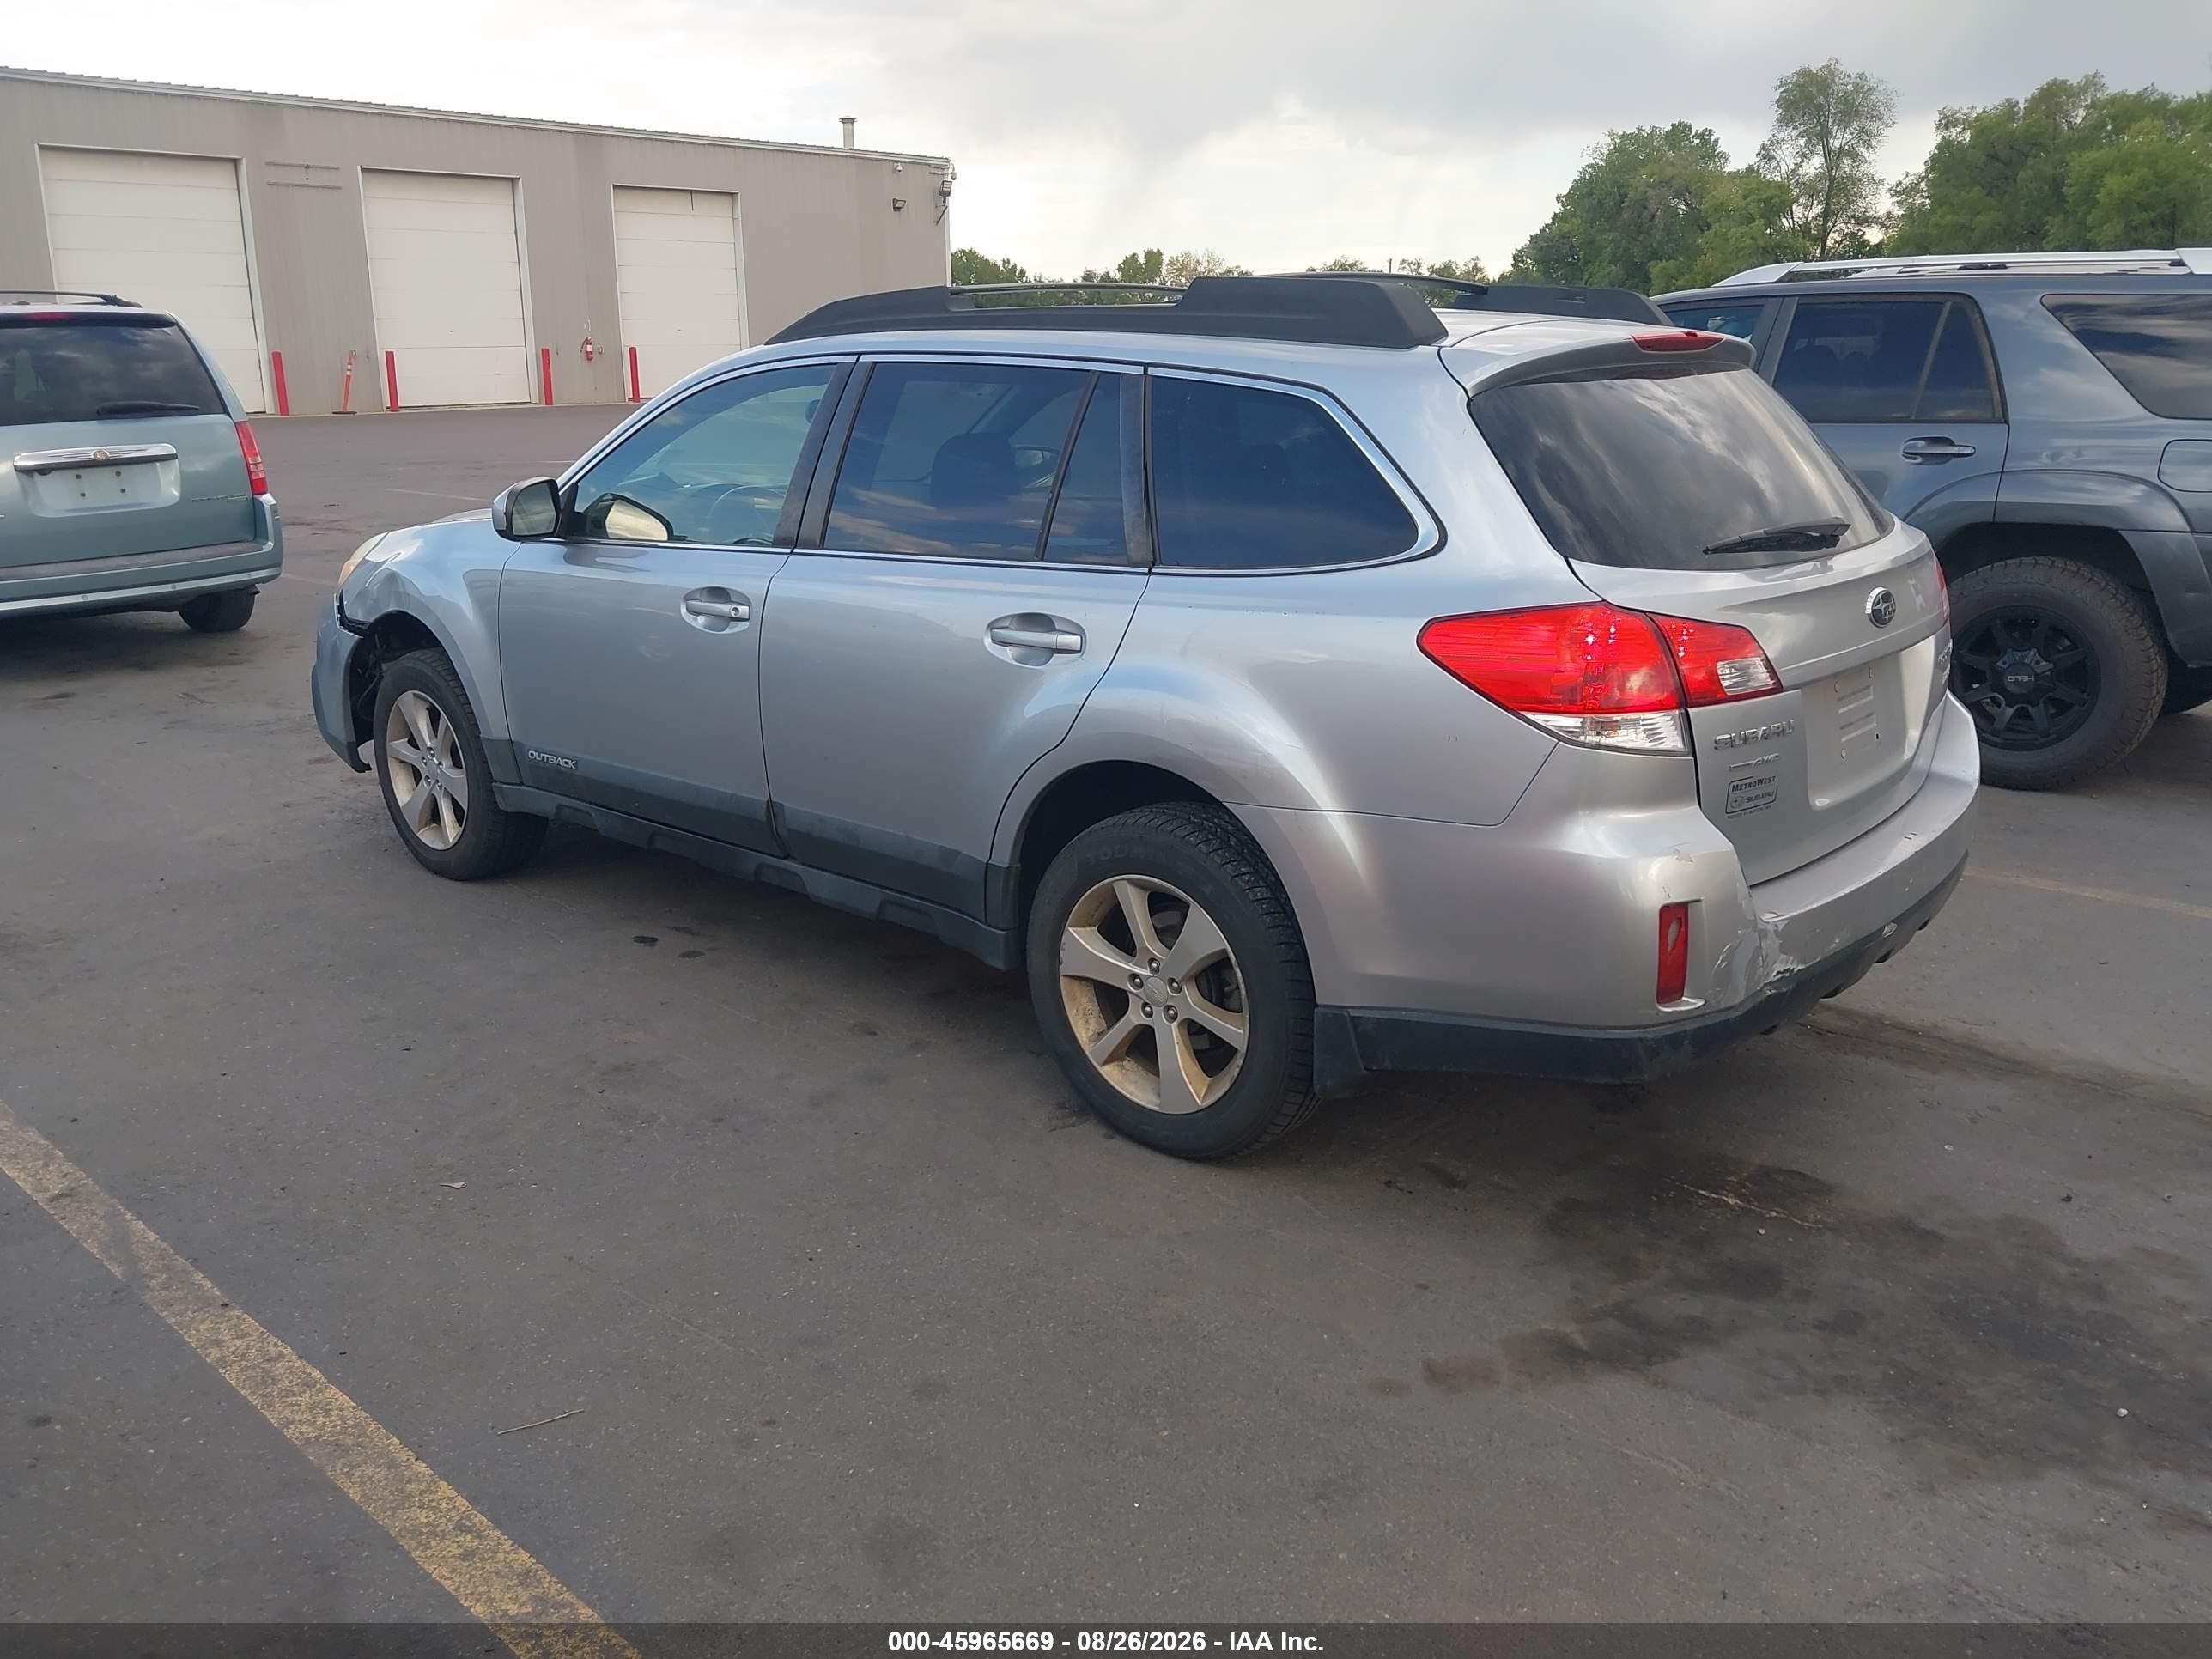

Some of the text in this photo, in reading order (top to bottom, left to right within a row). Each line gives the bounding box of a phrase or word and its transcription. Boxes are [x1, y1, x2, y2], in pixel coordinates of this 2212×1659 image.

[1714, 720, 1794, 750] SUBARU
[528, 750, 577, 770] OUTBACK
[1745, 790, 1776, 804] SUBARU
